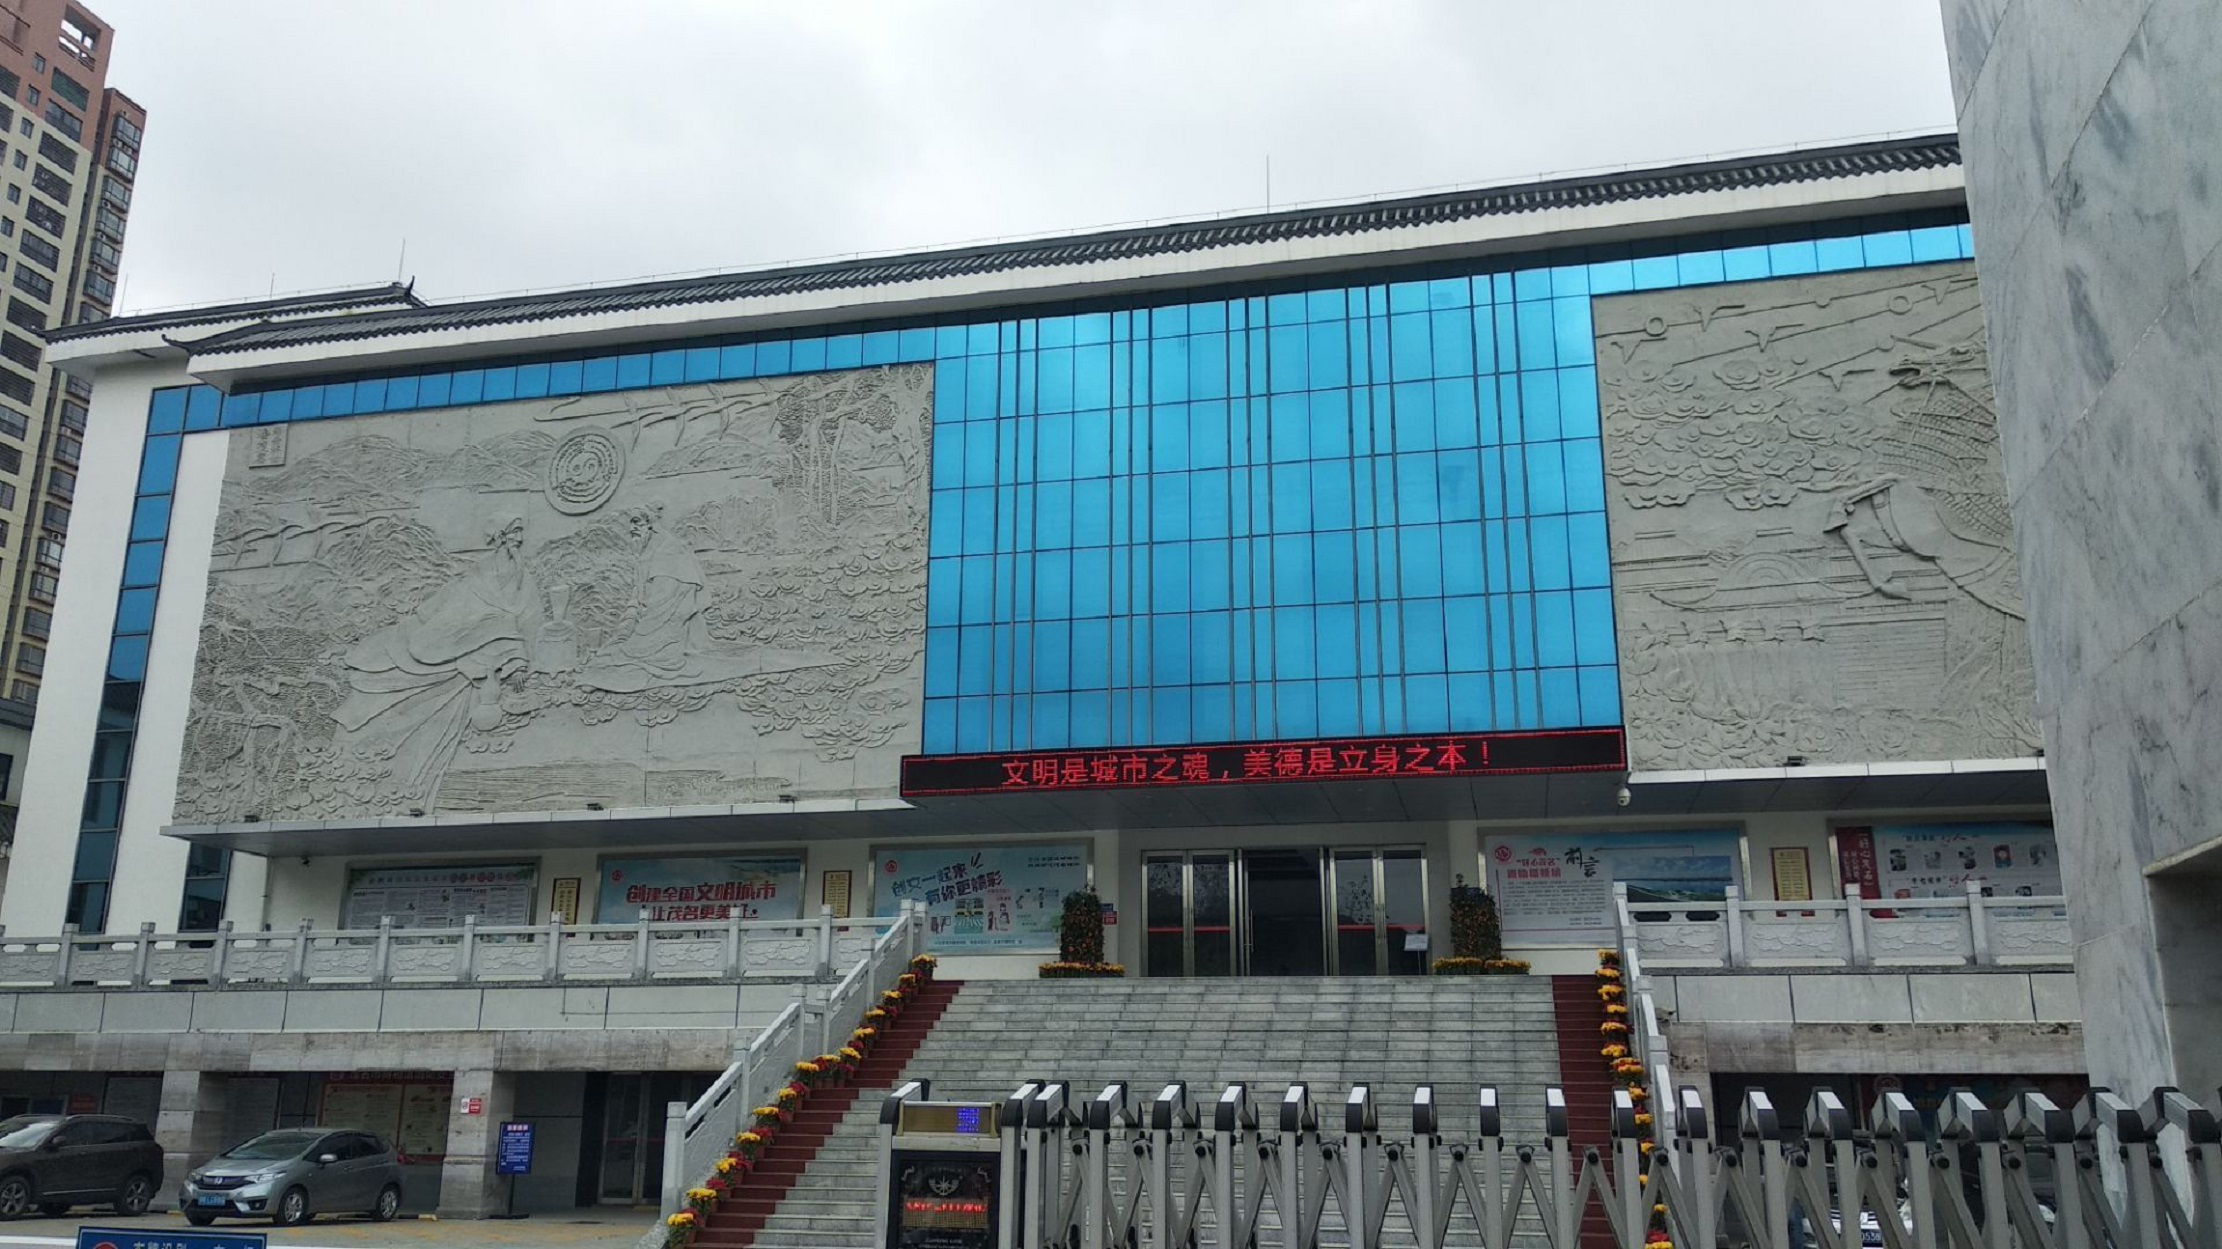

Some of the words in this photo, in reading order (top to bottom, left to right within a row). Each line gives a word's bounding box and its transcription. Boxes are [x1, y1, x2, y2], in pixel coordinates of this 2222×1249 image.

[1002, 741, 1489, 785] 文明是城市之魂，美德是立身之本！
[627, 880, 778, 903] 创建全国文明城市
